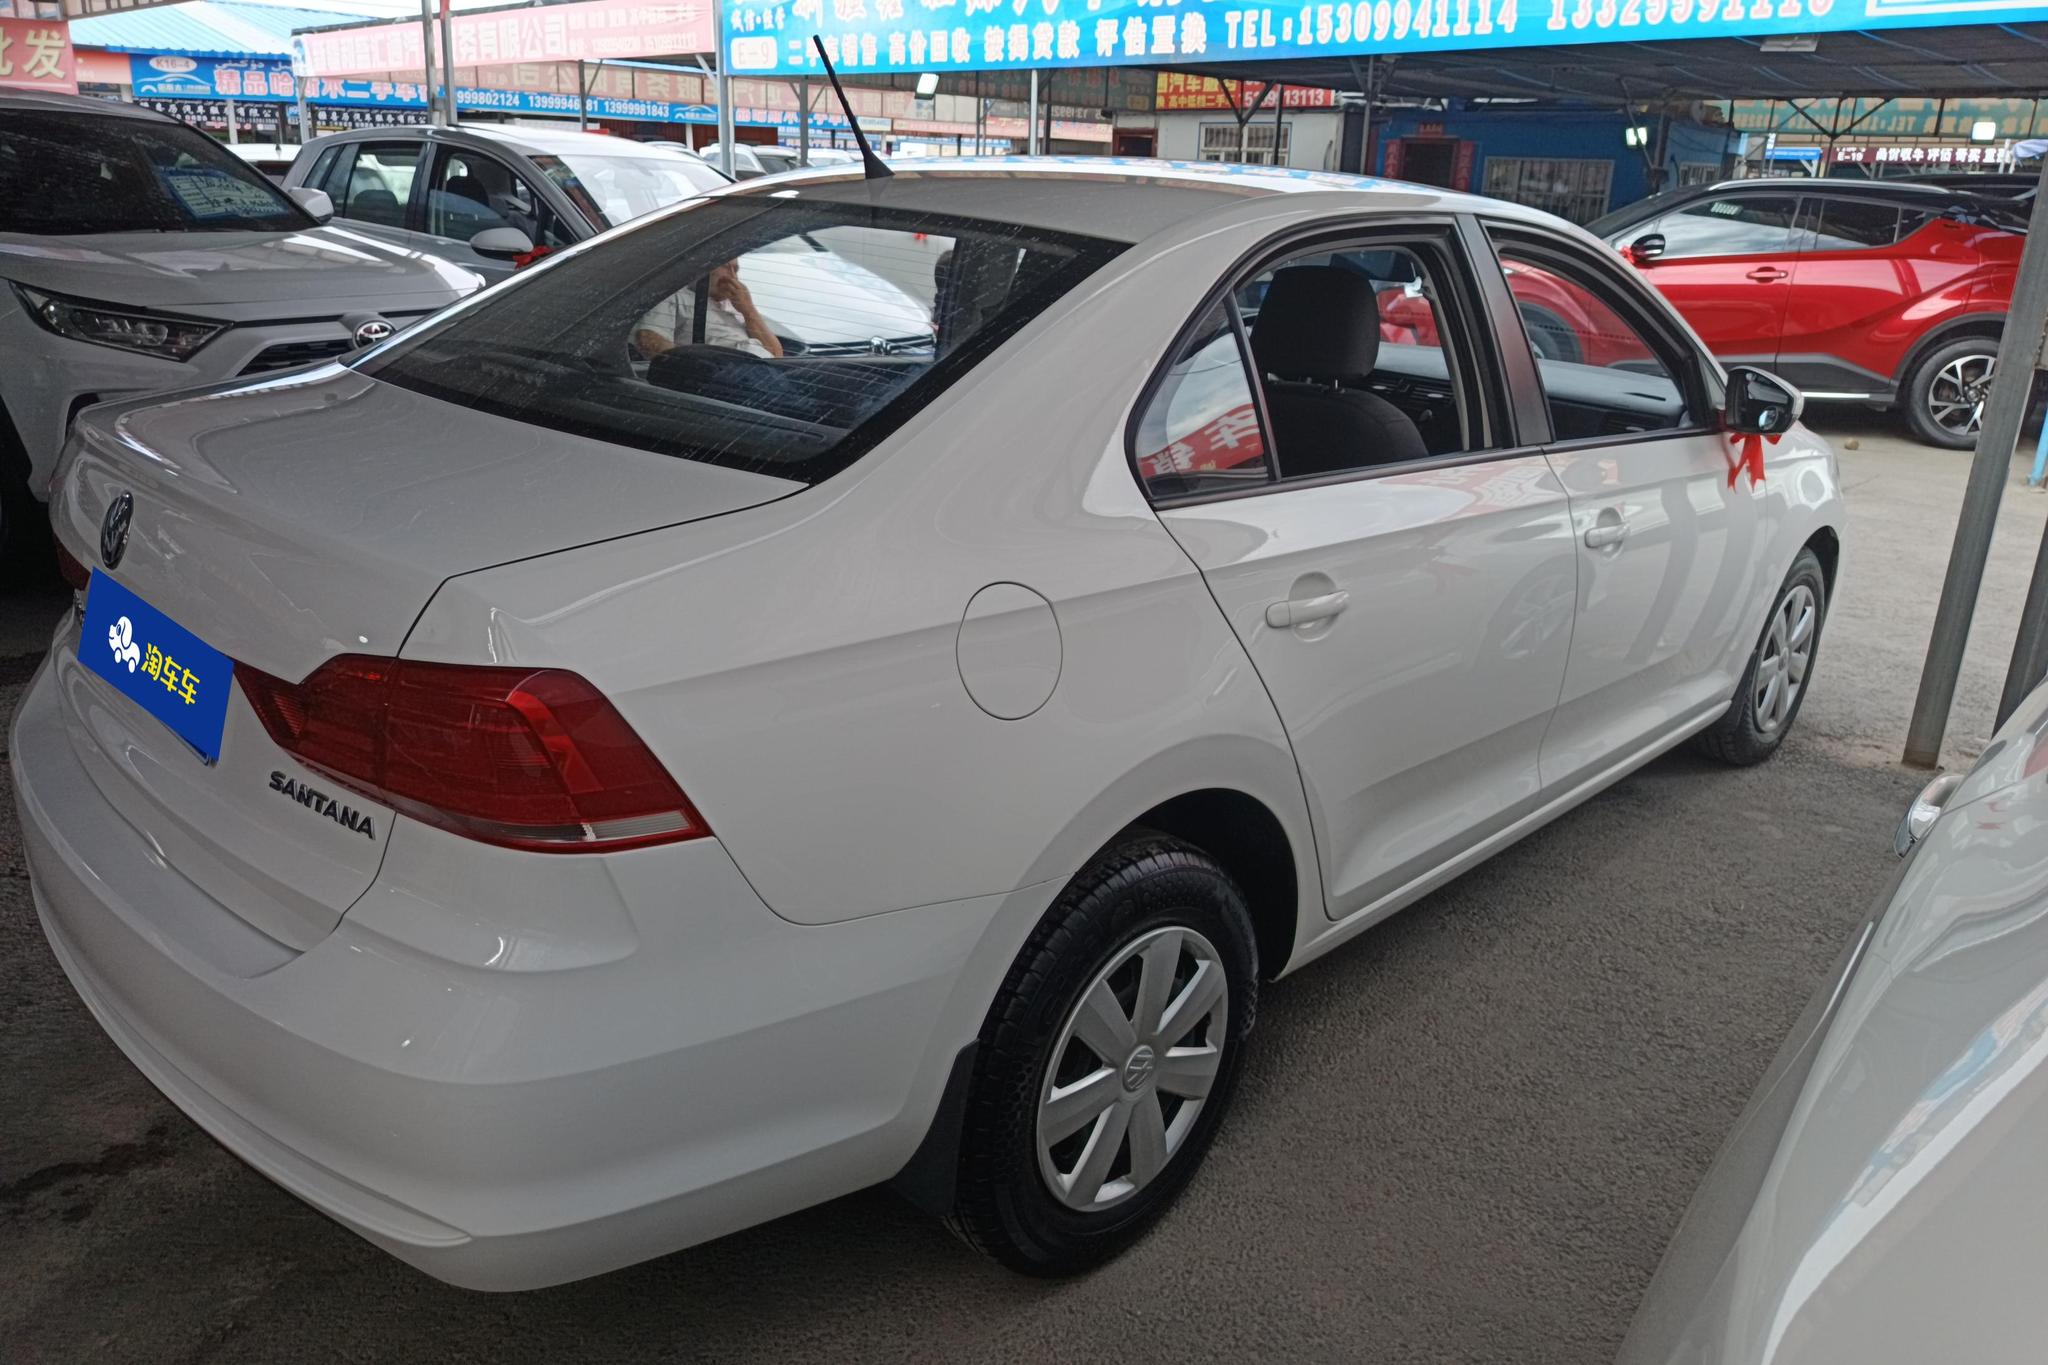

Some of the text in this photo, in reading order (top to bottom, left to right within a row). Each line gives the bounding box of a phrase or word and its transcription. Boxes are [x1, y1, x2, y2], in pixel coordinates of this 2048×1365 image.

[888, 28, 971, 66] 高价回收
[1095, 11, 1207, 57] 评估置换
[528, 95, 598, 112] 1399994681
[269, 770, 377, 841] SANTANA
